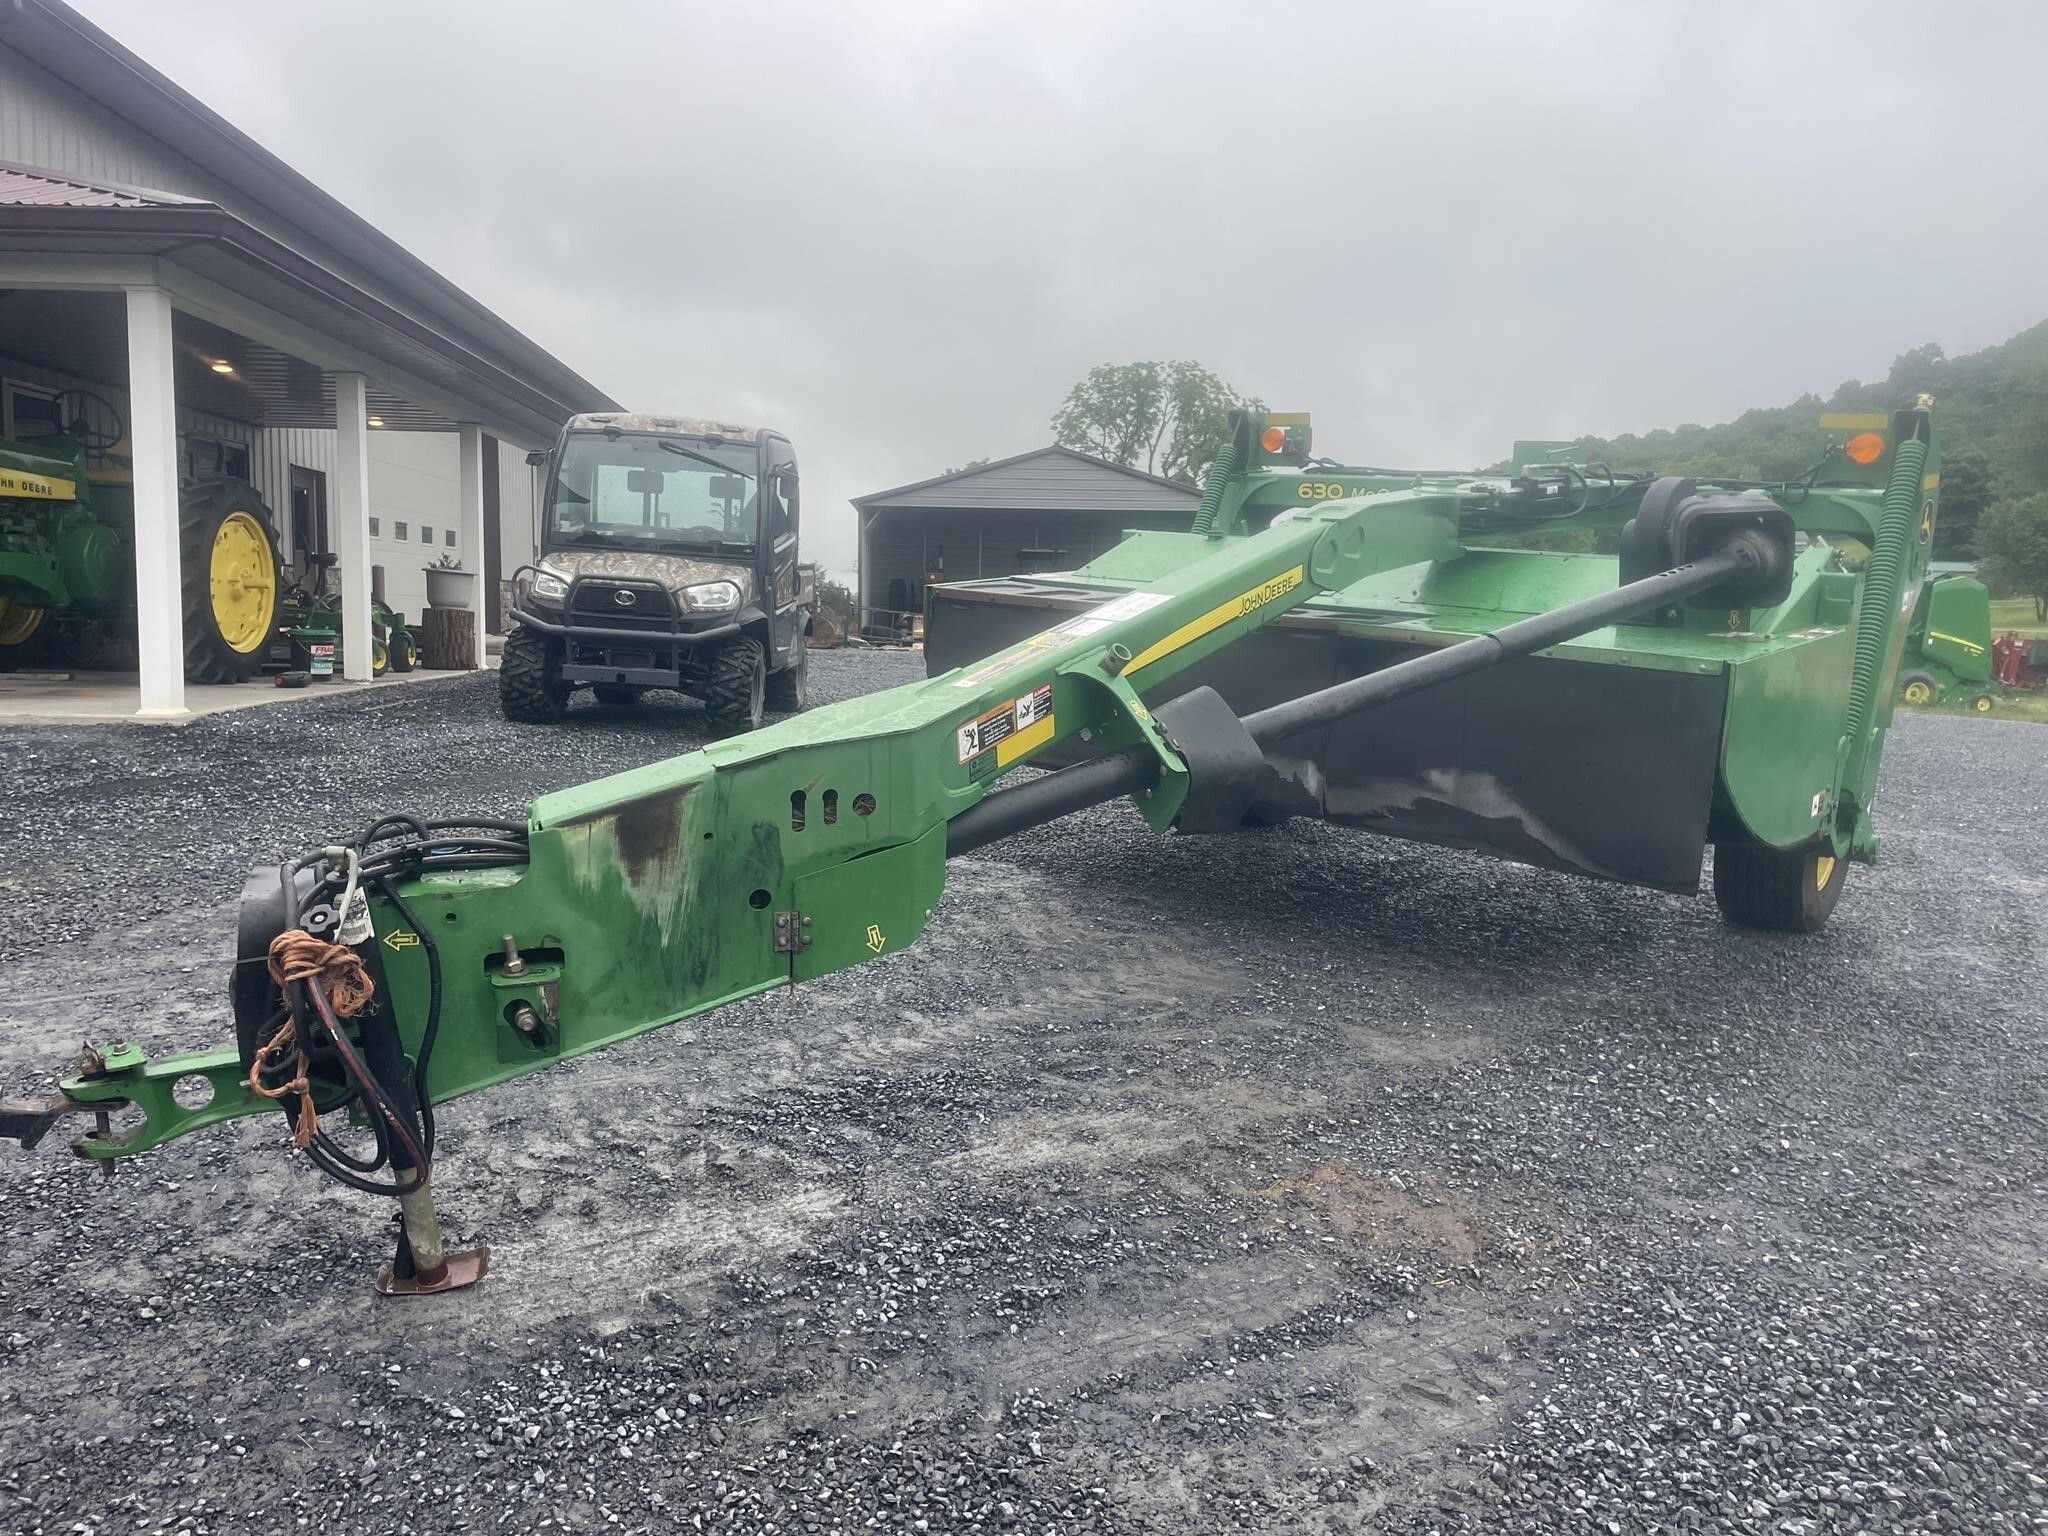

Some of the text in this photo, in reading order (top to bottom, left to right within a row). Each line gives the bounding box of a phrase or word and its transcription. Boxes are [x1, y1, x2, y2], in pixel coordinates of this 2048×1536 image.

[0, 477, 53, 496] HN DEERE
[1297, 482, 1344, 500] 630
[1239, 576, 1294, 617] JOHN DEERE
